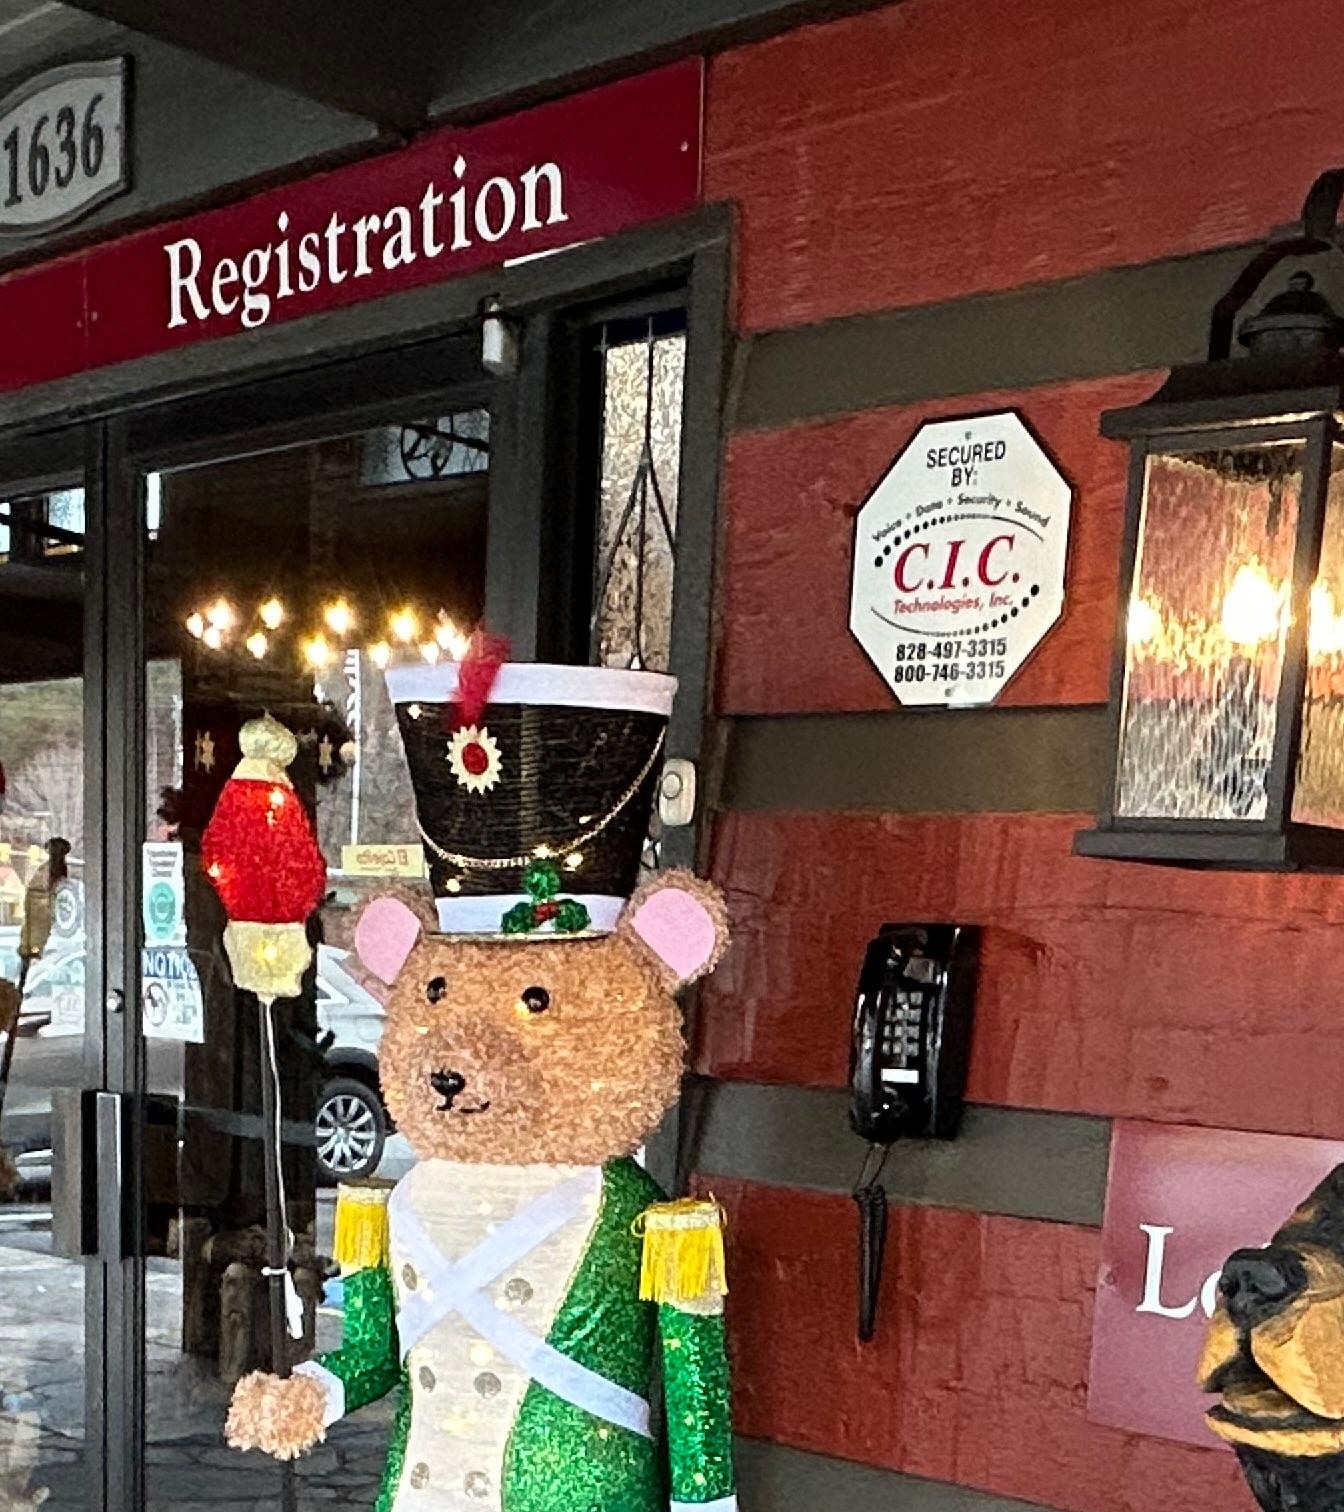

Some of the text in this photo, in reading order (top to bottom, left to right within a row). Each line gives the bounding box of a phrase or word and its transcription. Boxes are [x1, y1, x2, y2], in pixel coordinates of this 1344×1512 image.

[2, 92, 105, 209] 1636
[163, 155, 568, 331] Registration
[926, 440, 1007, 469] SECURED
[950, 467, 979, 487] BY:
[957, 493, 1002, 511] Security
[1014, 500, 1052, 528] Sound
[893, 534, 1020, 594] C.I.C.
[893, 593, 984, 615] Technologies,
[896, 637, 1007, 662] 828-497-3315
[894, 660, 1005, 684] 800-746-3315
